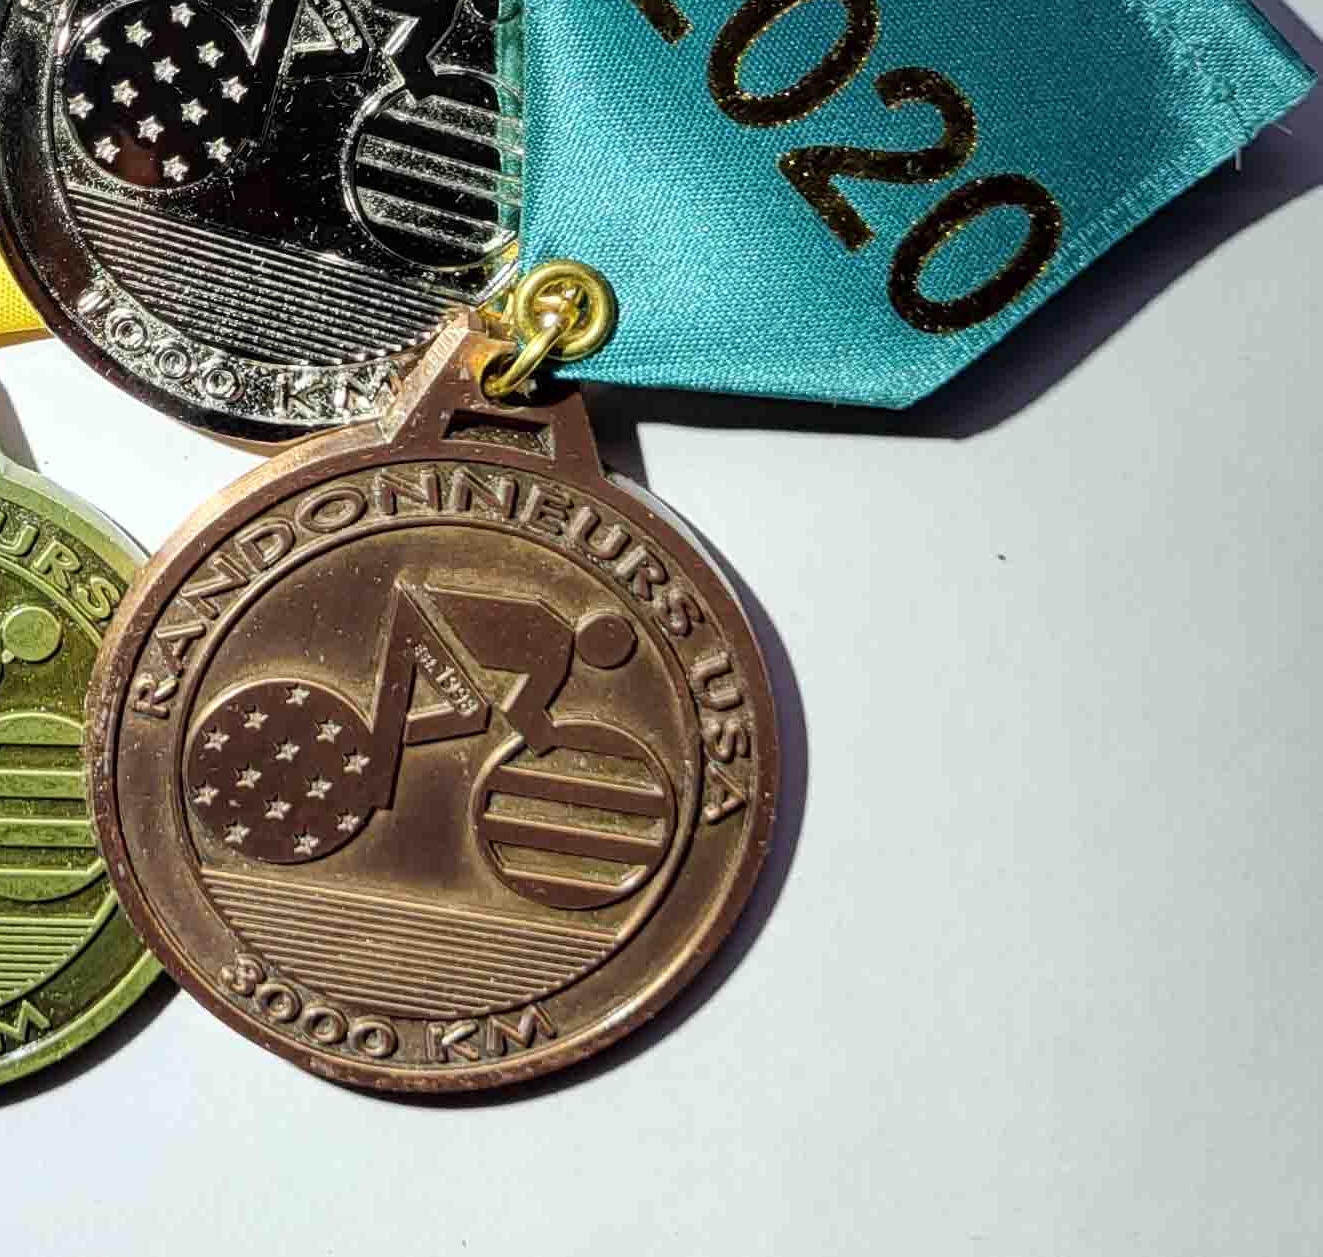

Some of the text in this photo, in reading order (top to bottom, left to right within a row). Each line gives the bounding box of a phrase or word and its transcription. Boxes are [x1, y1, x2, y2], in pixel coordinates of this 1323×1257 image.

[78, 288, 245, 401] 1000
[128, 465, 757, 827] RANDONNEURS USA
[426, 1002, 559, 1065] KM
